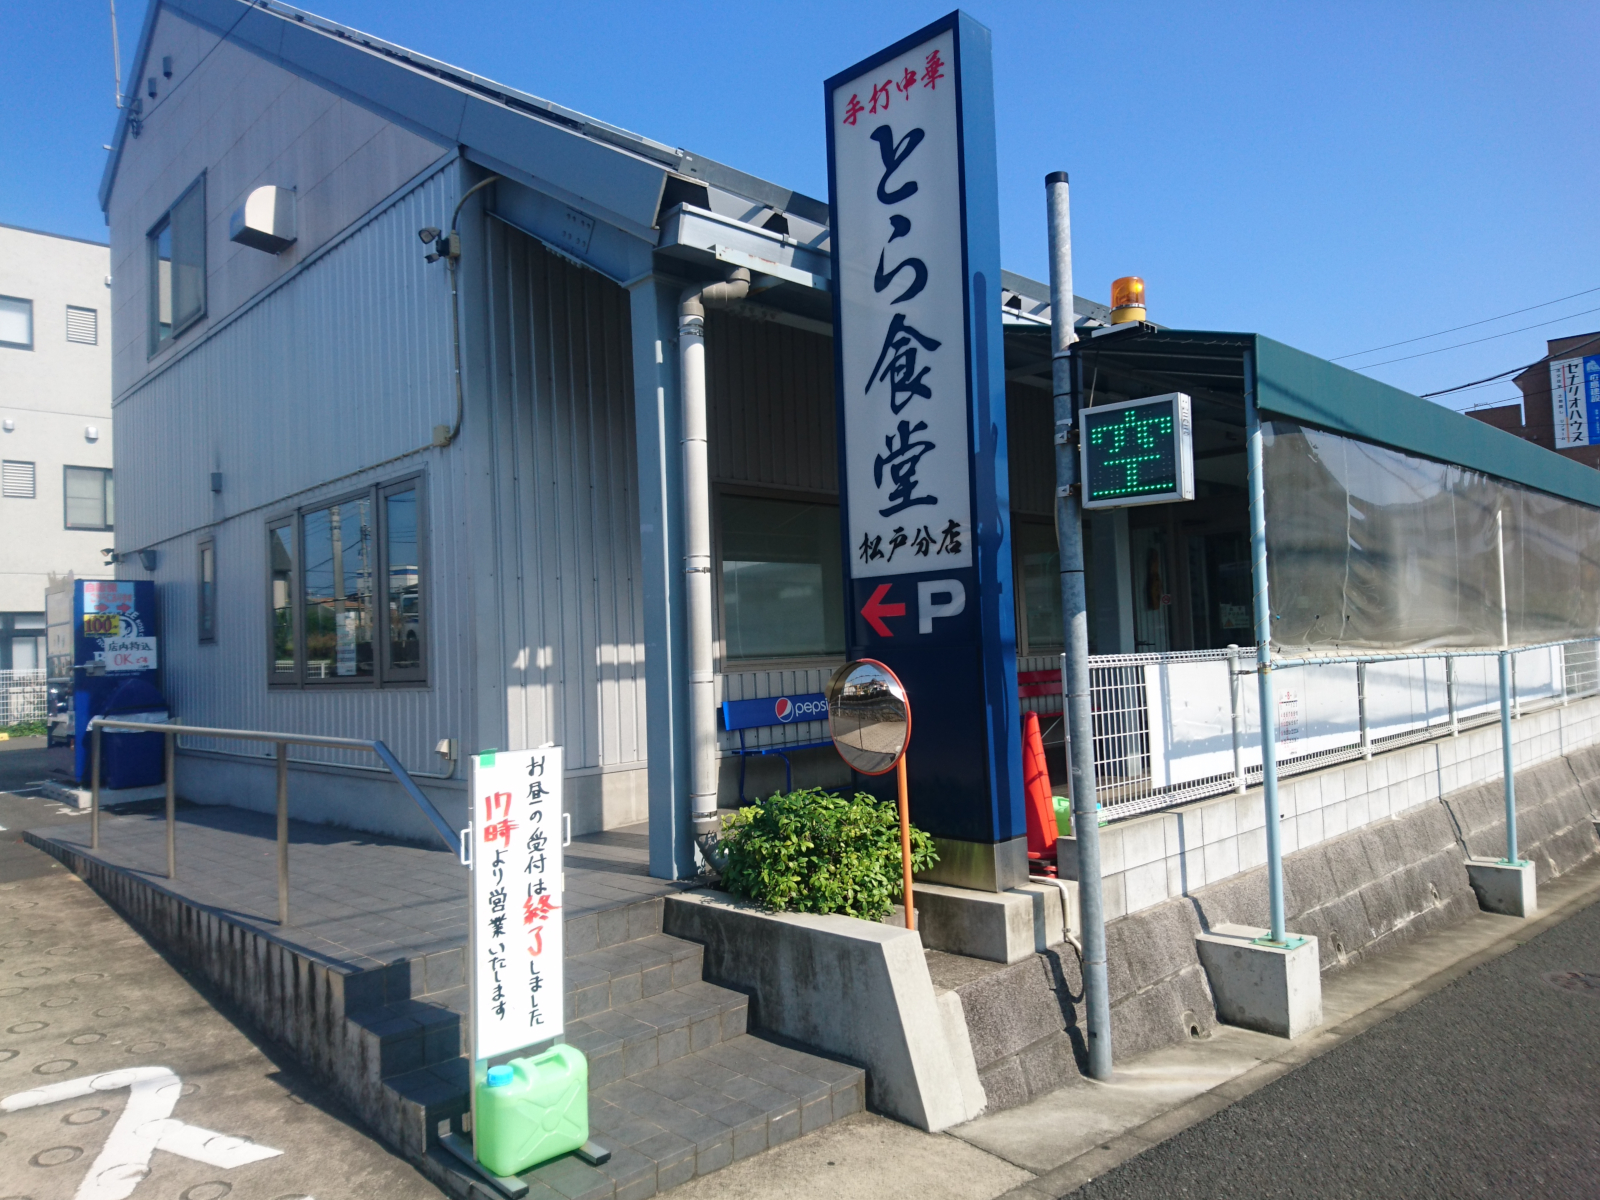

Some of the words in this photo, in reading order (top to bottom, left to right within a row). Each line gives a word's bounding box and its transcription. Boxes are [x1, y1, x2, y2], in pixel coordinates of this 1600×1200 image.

[843, 49, 945, 126] 手打中華
[865, 124, 942, 518] とら食堂
[1567, 364, 1583, 442] セナリオハウス
[1091, 410, 1174, 496] 空
[859, 519, 962, 564] 松戸分店
[84, 617, 112, 633] 100
[917, 578, 966, 635] P
[108, 641, 154, 652] 店内持込
[795, 697, 829, 717] pepsi
[483, 791, 520, 1021] 17時より営業いたします
[522, 755, 562, 1027] お昼の受付は終了しました
